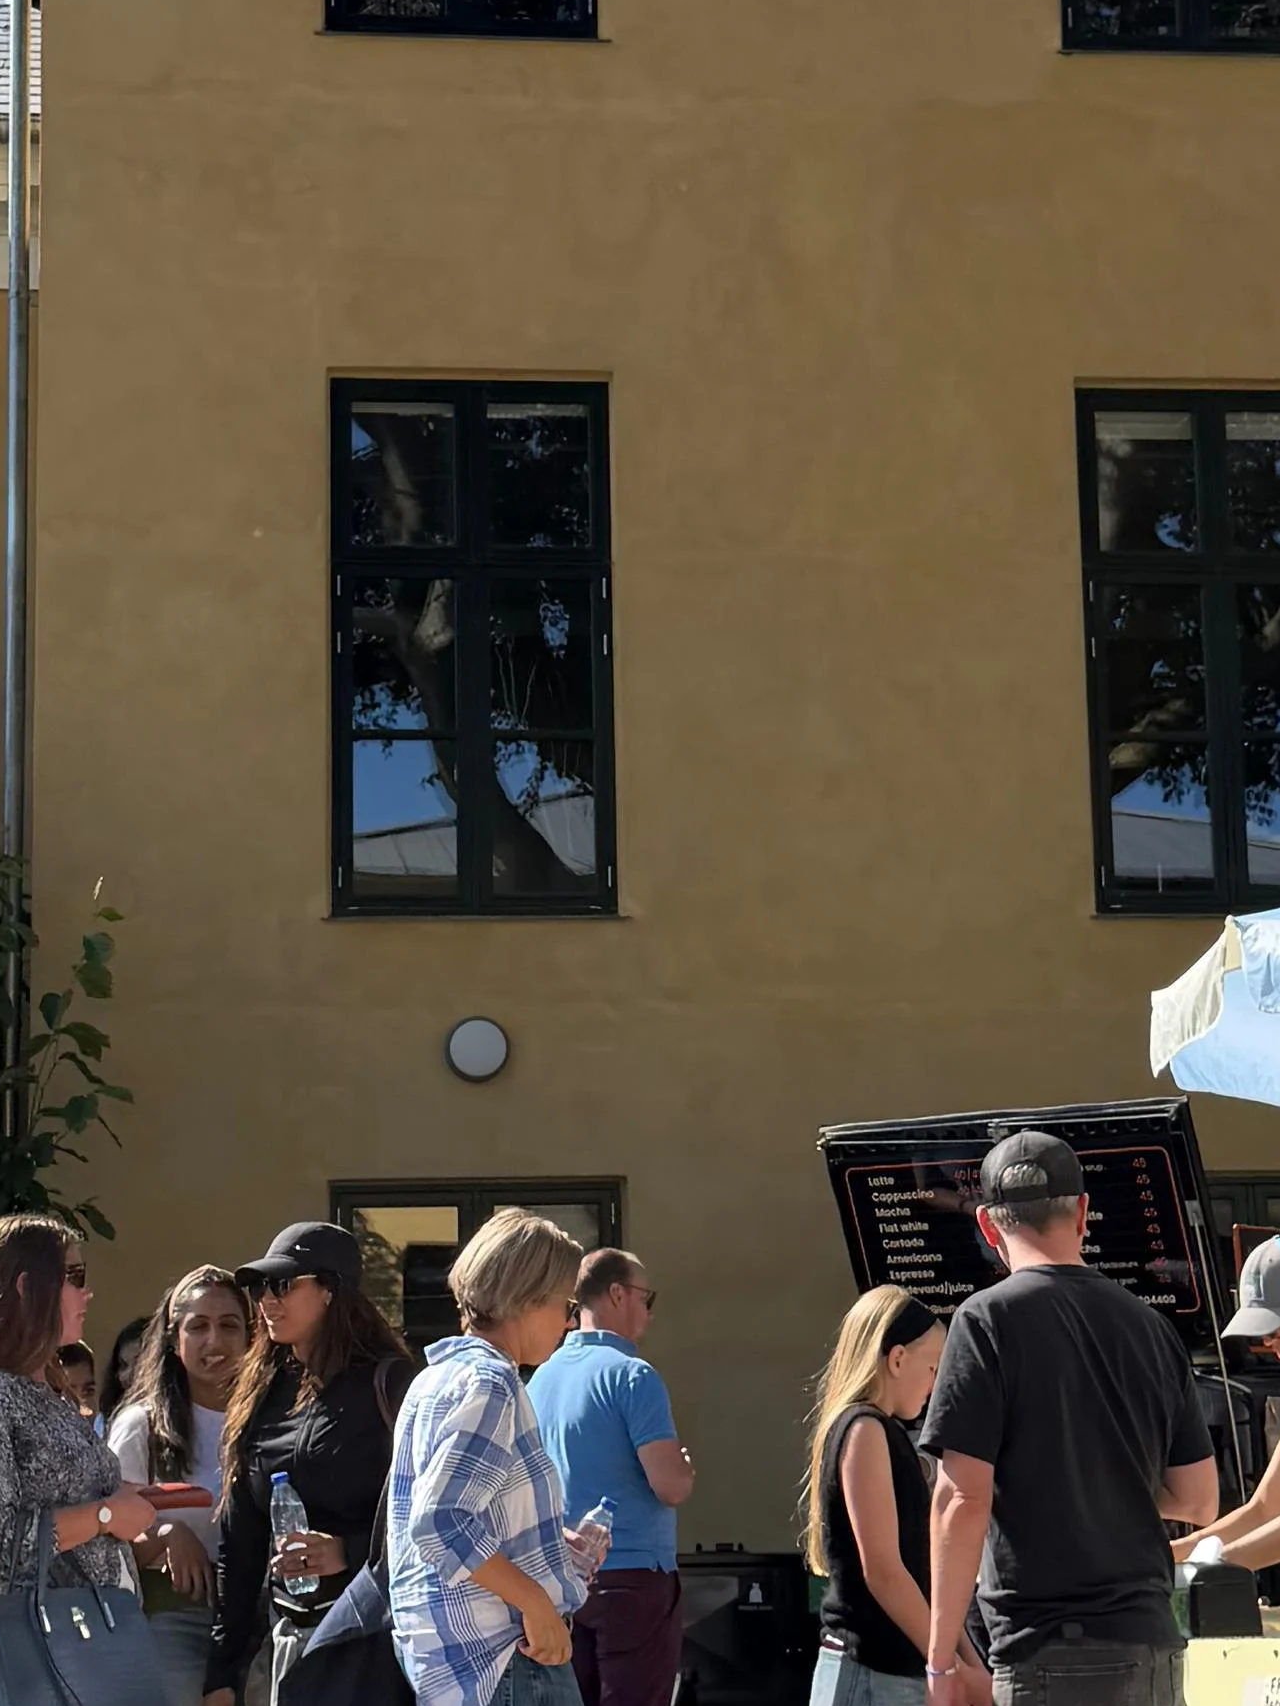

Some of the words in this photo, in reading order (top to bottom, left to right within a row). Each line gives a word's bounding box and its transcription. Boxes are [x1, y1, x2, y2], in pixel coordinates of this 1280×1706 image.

[867, 1176, 895, 1187] Latte
[871, 1189, 935, 1204] Cappuccino
[875, 1207, 911, 1218] Mocha
[878, 1222, 899, 1233] Flat
[900, 1221, 929, 1232] white
[882, 1238, 925, 1249] Cortado
[886, 1253, 943, 1264] Americano
[889, 1269, 935, 1282] Espresso
